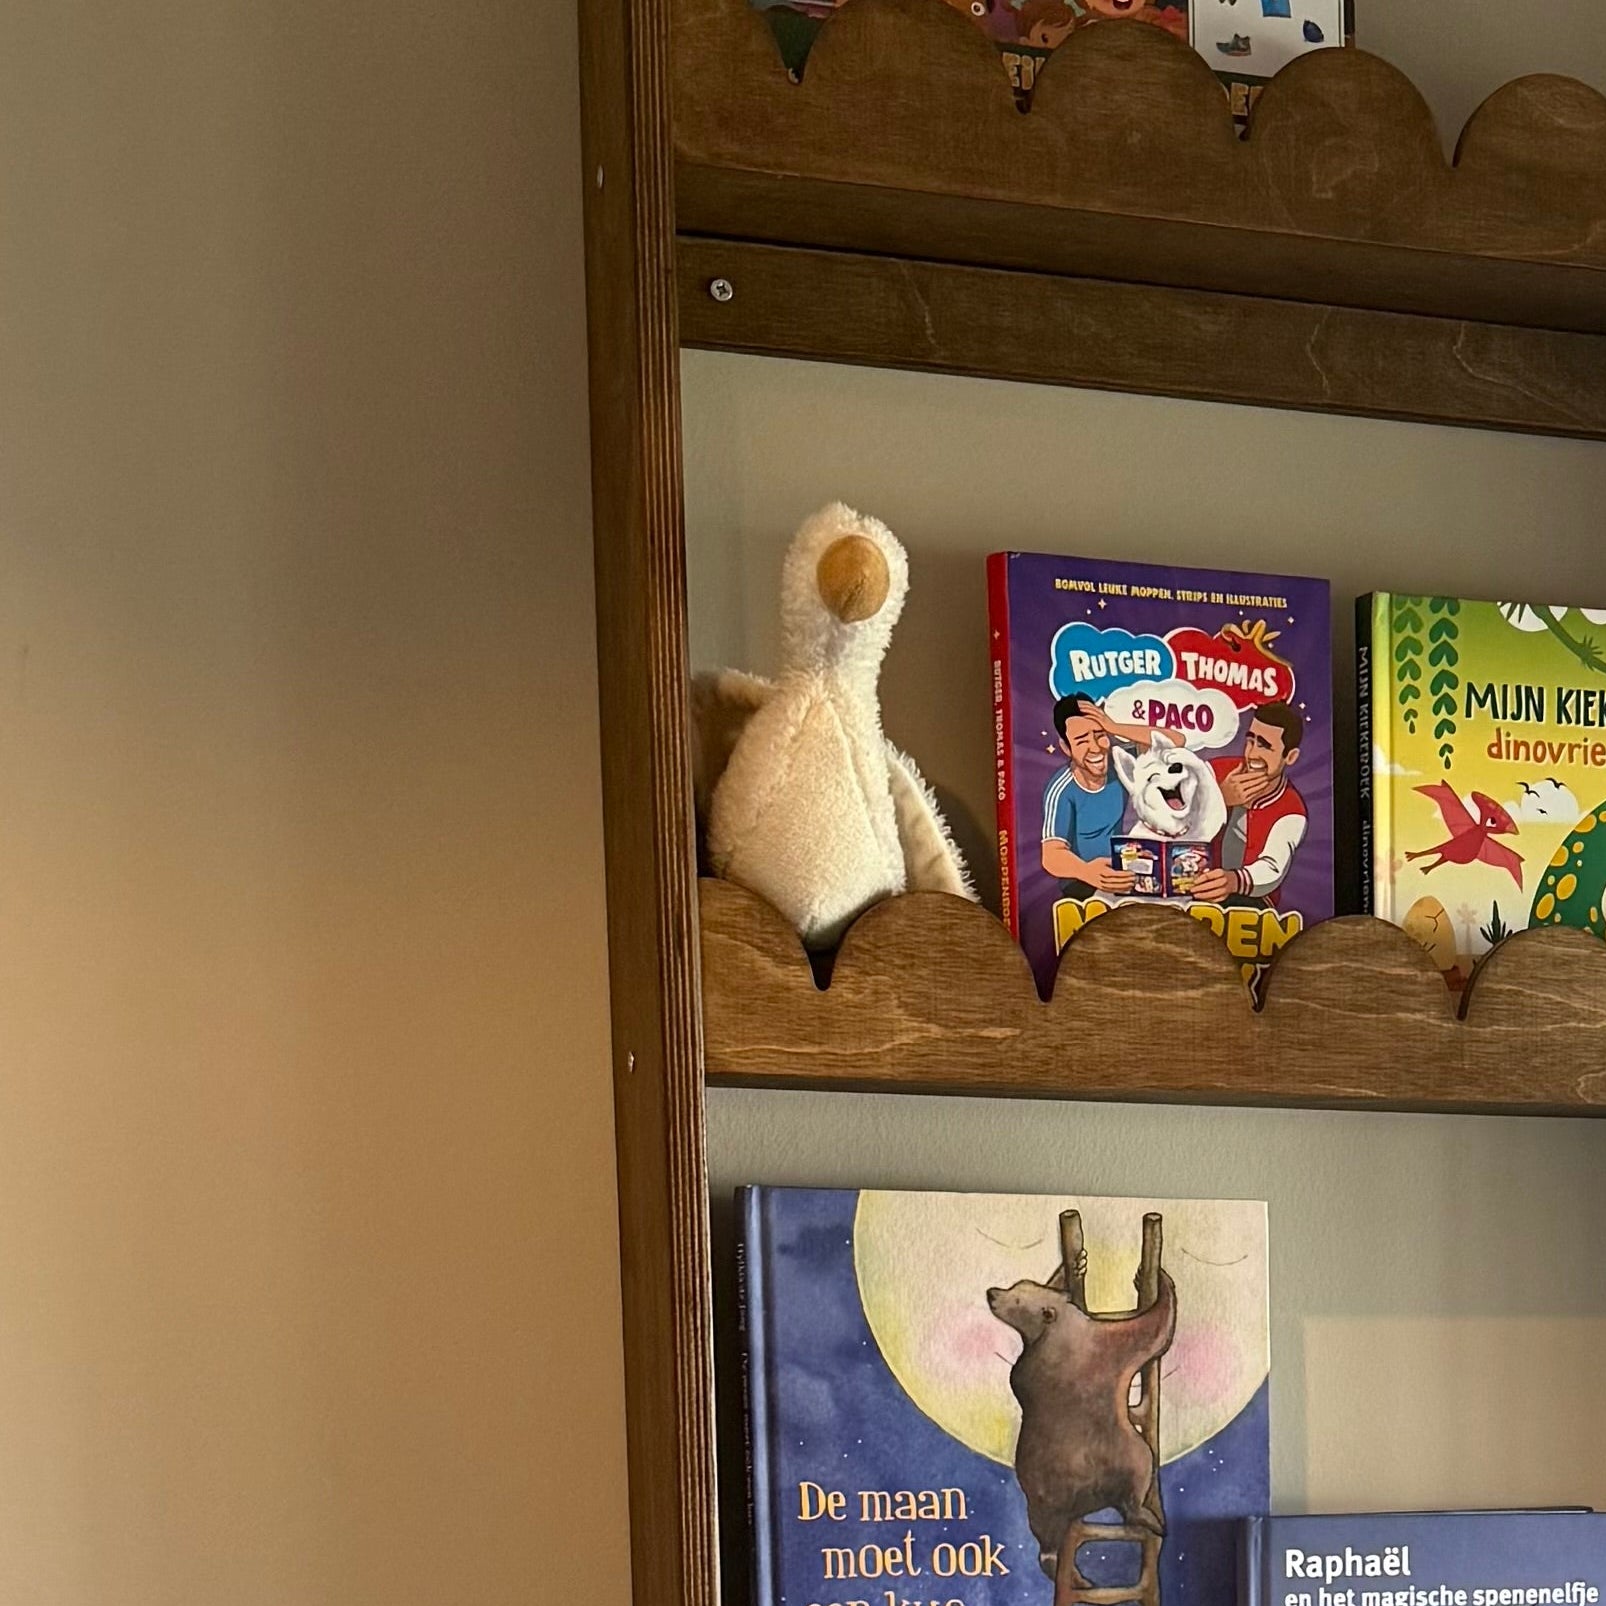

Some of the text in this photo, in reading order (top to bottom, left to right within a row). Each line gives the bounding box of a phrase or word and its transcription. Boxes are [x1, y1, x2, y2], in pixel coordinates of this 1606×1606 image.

[1055, 578, 1096, 592] BOMVOL
[1098, 583, 1128, 596] LEUKE
[1176, 590, 1208, 603] STRIPS
[1211, 592, 1223, 604] EN
[1226, 595, 1288, 609] ILLUSTRATIES
[1069, 649, 1162, 682] RUTGER
[1180, 652, 1279, 697] THOMAS
[1358, 646, 1369, 698] MIJN
[1131, 699, 1214, 732] & PACO
[1465, 682, 1544, 722] MIJN
[995, 709, 1005, 756] THOMAS
[1359, 702, 1370, 800] KIEKEBOEK
[998, 771, 1006, 801] PACO
[797, 1481, 968, 1522] De maan
[821, 1529, 1011, 1579] moet ook
[1285, 1546, 1411, 1584] Raphaël
